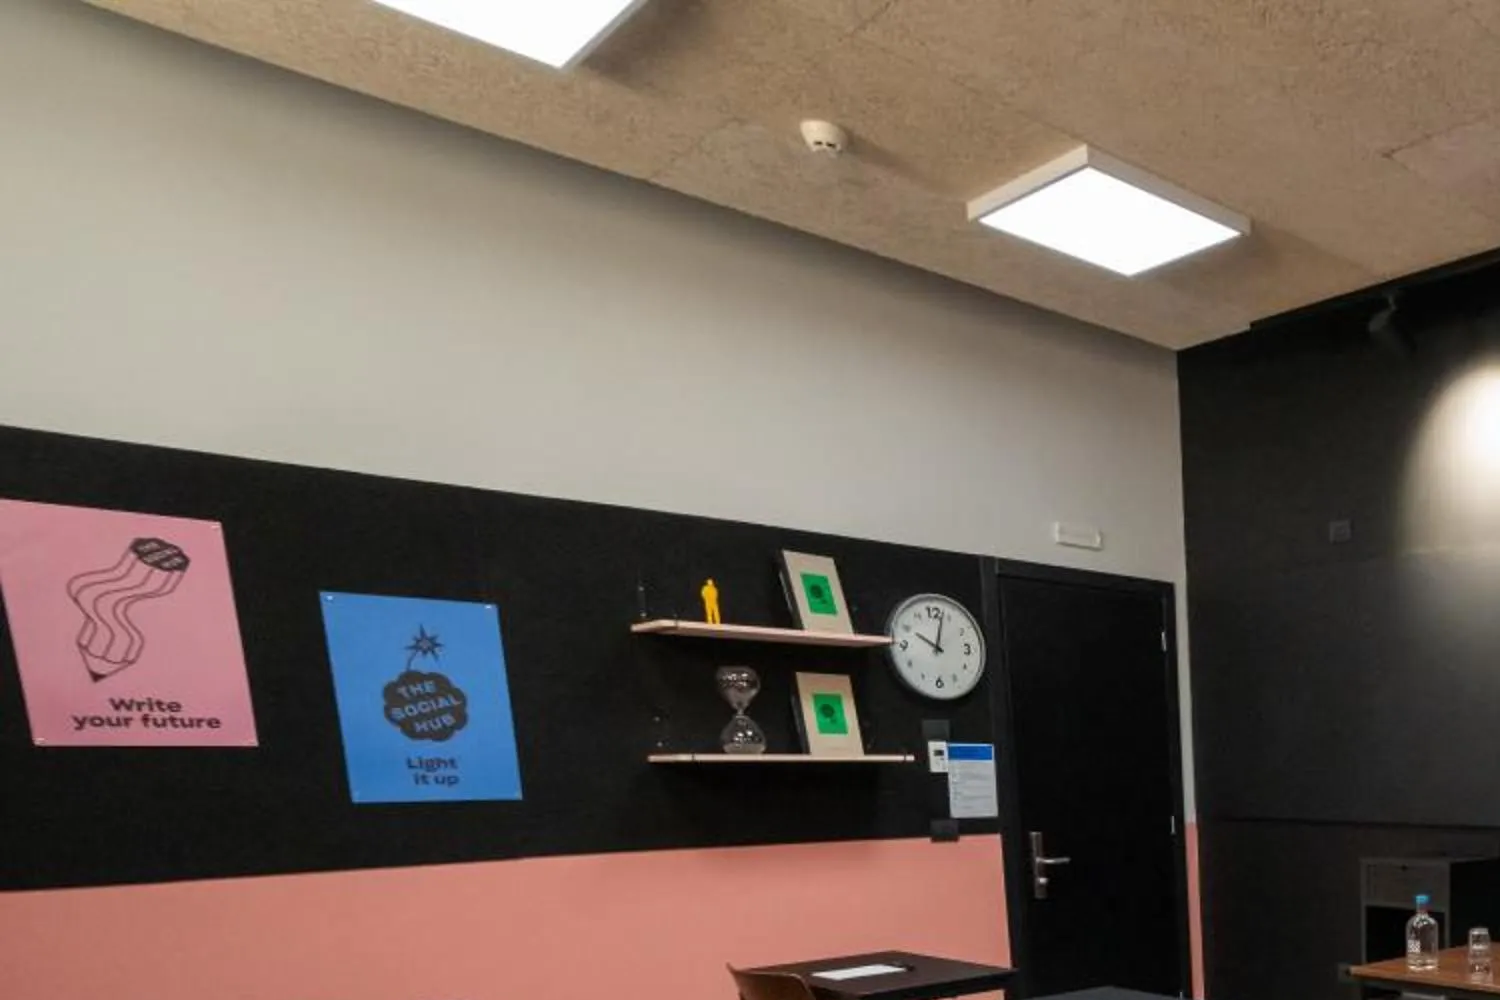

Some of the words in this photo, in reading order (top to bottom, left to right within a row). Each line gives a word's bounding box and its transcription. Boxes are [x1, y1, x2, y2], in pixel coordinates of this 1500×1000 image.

[926, 605, 940, 619] 12
[963, 643, 972, 656] 3
[397, 680, 435, 699] THE
[935, 676, 945, 689] 6
[108, 697, 182, 713] Write
[391, 694, 461, 719] SOCIAL
[71, 715, 134, 731] your
[141, 713, 221, 729] future
[415, 714, 455, 732] HUB
[406, 757, 458, 773] Light
[413, 772, 430, 785] it
[433, 775, 460, 787] up
